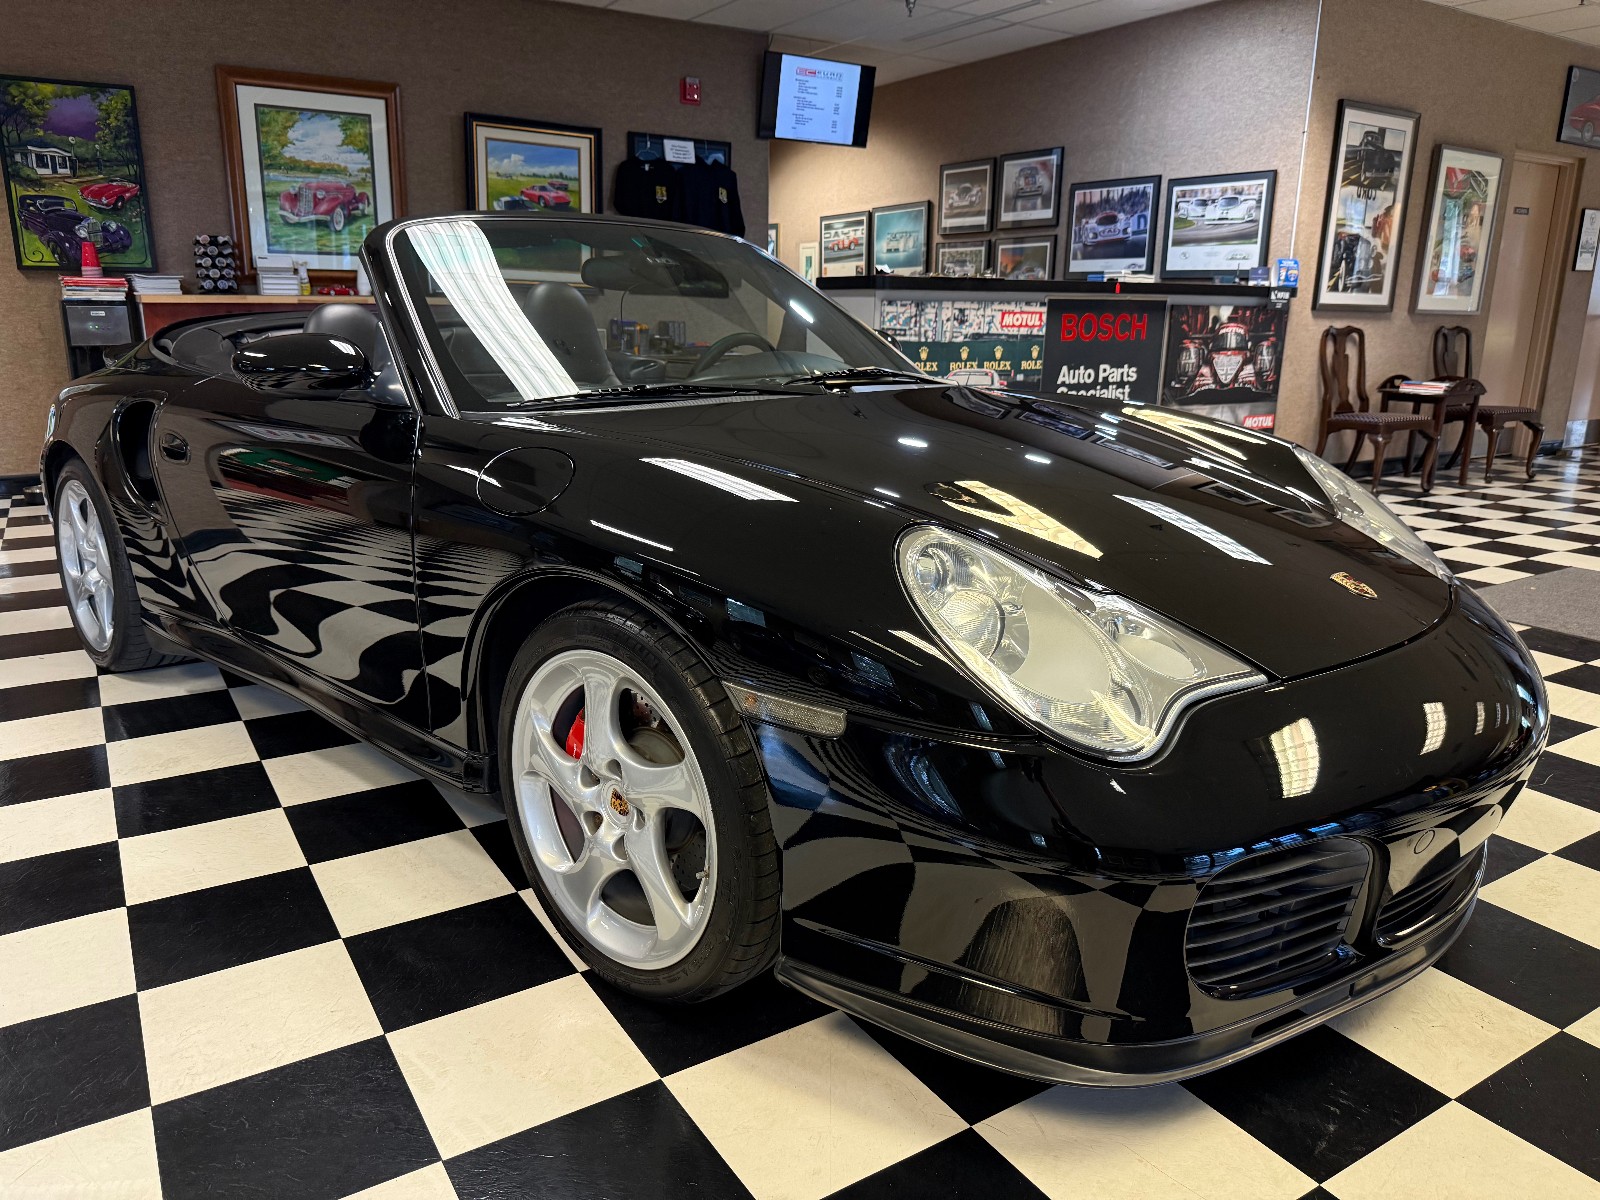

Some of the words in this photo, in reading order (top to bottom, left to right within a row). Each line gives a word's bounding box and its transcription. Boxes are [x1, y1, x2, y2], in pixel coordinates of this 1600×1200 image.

[1002, 313, 1041, 326] MOTUL
[1061, 313, 1148, 341] BOSCH
[914, 361, 938, 371] OLEX
[950, 361, 977, 371] ROLEX
[983, 361, 1011, 371] ROLEX
[1021, 360, 1042, 370] ROLE
[1057, 365, 1095, 384] Auto
[1098, 364, 1137, 382] Parts
[1057, 384, 1131, 401] cialist
[1244, 416, 1273, 428] MOTUL
